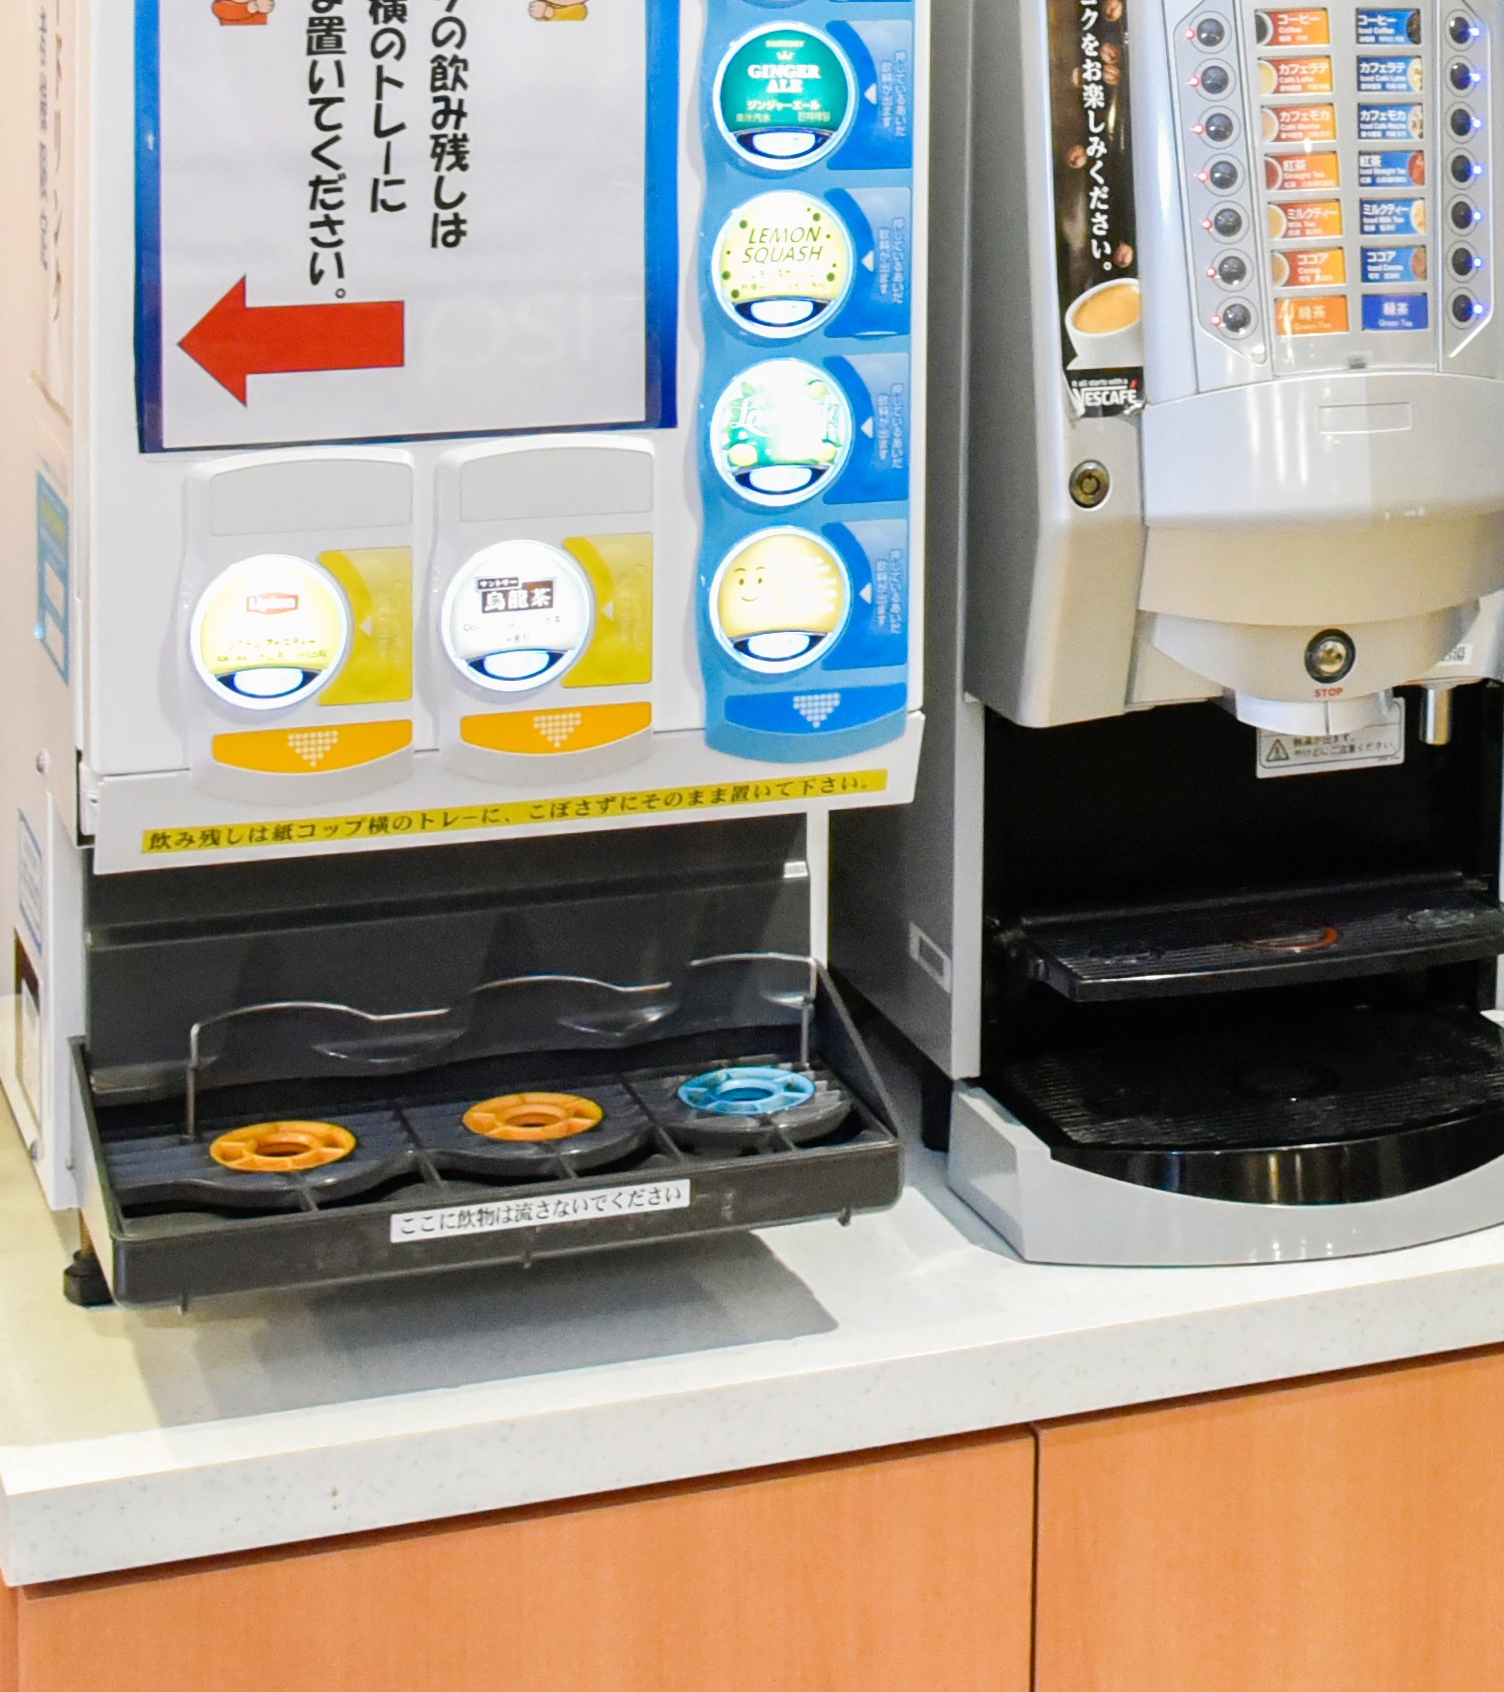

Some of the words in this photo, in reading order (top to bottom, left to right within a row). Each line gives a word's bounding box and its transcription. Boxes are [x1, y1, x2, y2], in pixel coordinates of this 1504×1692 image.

[1277, 14, 1320, 25] コーヒー
[1357, 15, 1397, 25] コーヒー
[748, 64, 821, 79] GINGER
[1278, 63, 1329, 75] カフェラテ
[1359, 63, 1406, 74] カフェラテ
[766, 79, 803, 94] ALE
[1279, 110, 1331, 122] カフェモカ
[1359, 110, 1407, 122] カフェモカ
[1282, 160, 1307, 171] 紅茶
[1359, 155, 1381, 168] 紅茶
[1287, 208, 1338, 220] ミルクティー
[1363, 204, 1409, 216] ミルクティー
[748, 227, 821, 244] LEMON
[742, 246, 823, 264] SQUASH
[1297, 253, 1328, 265] ココア
[1367, 251, 1395, 262] ココア
[1314, 687, 1343, 698] STOP
[398, 1184, 684, 1238] ここに飲物は流さないでください
